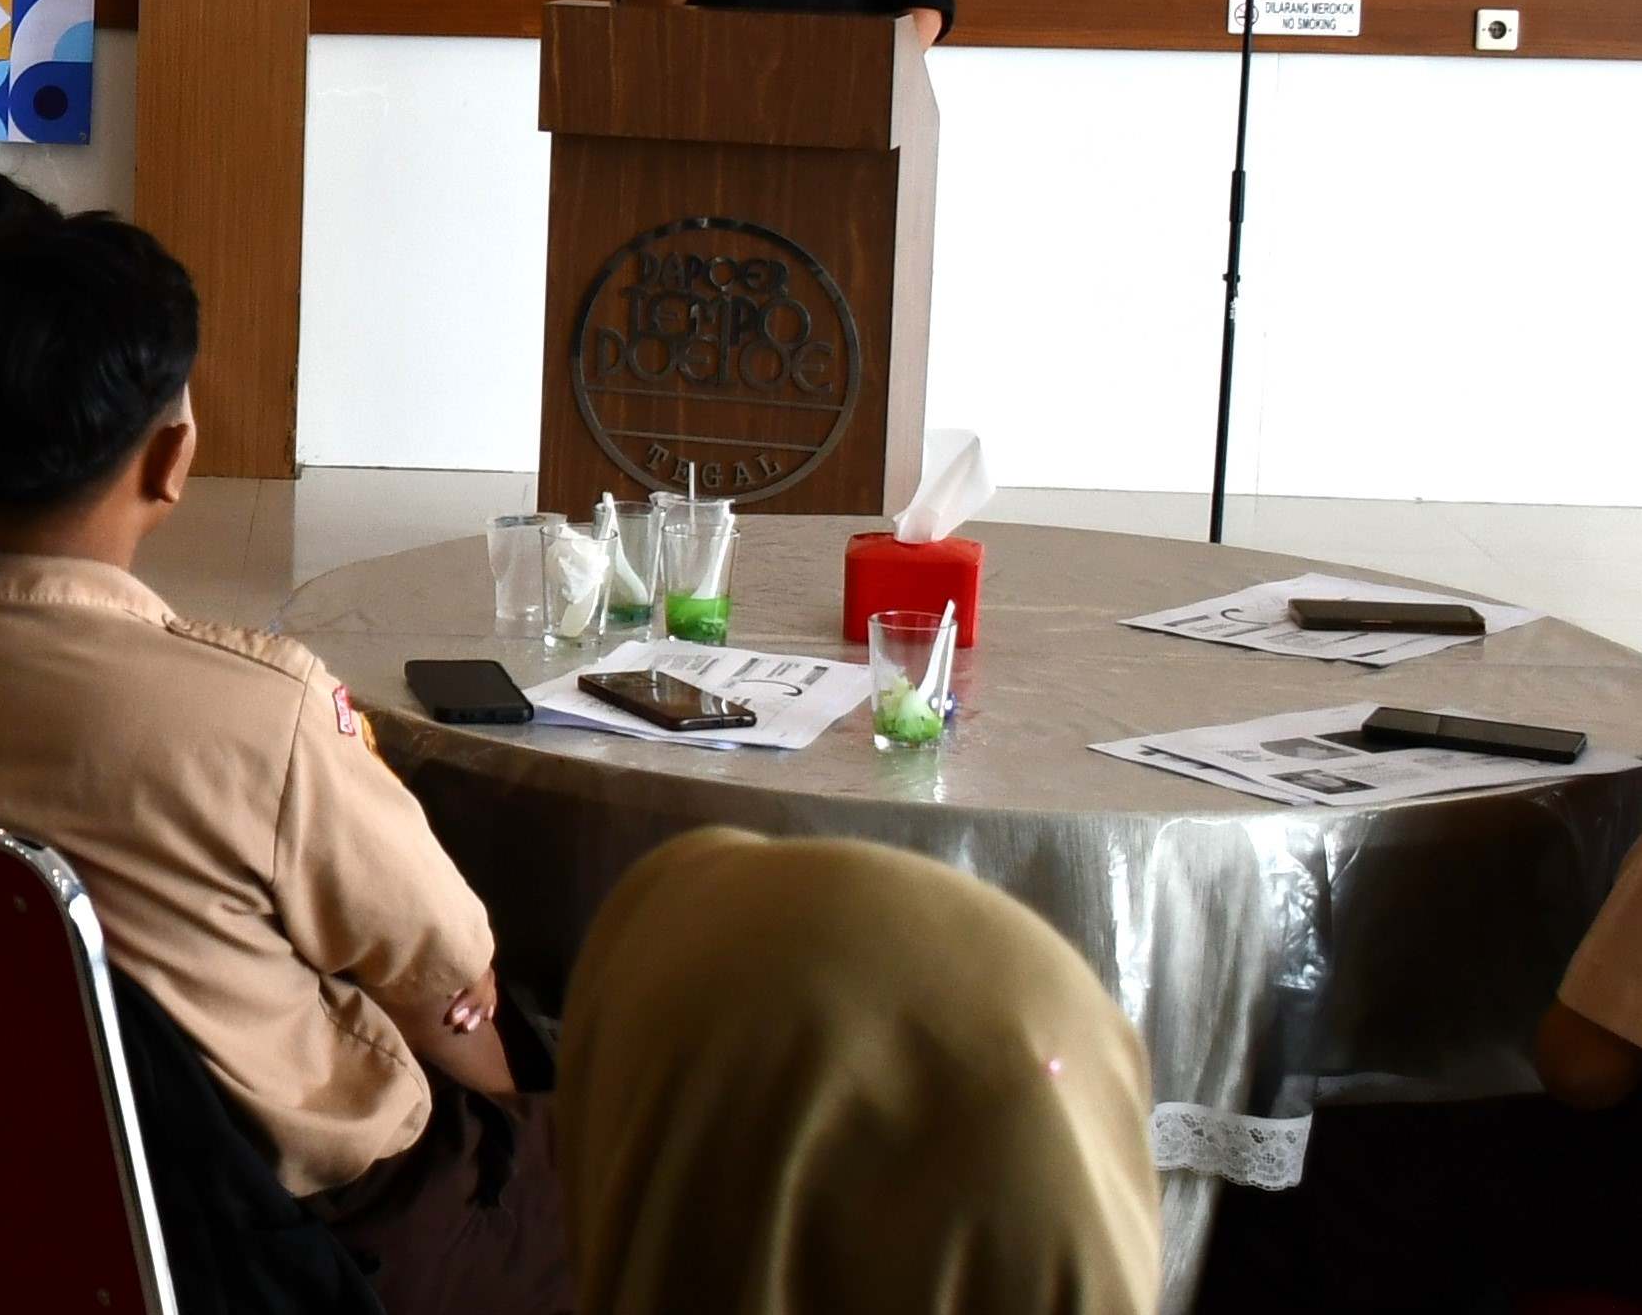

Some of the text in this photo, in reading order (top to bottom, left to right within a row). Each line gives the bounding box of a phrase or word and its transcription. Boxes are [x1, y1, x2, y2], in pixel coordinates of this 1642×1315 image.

[1265, 1, 1354, 15] DILARANG MEROKOK
[1282, 17, 1336, 30] NO SMOKING
[639, 251, 790, 298] DAPOER
[645, 443, 782, 490] TEGAL
